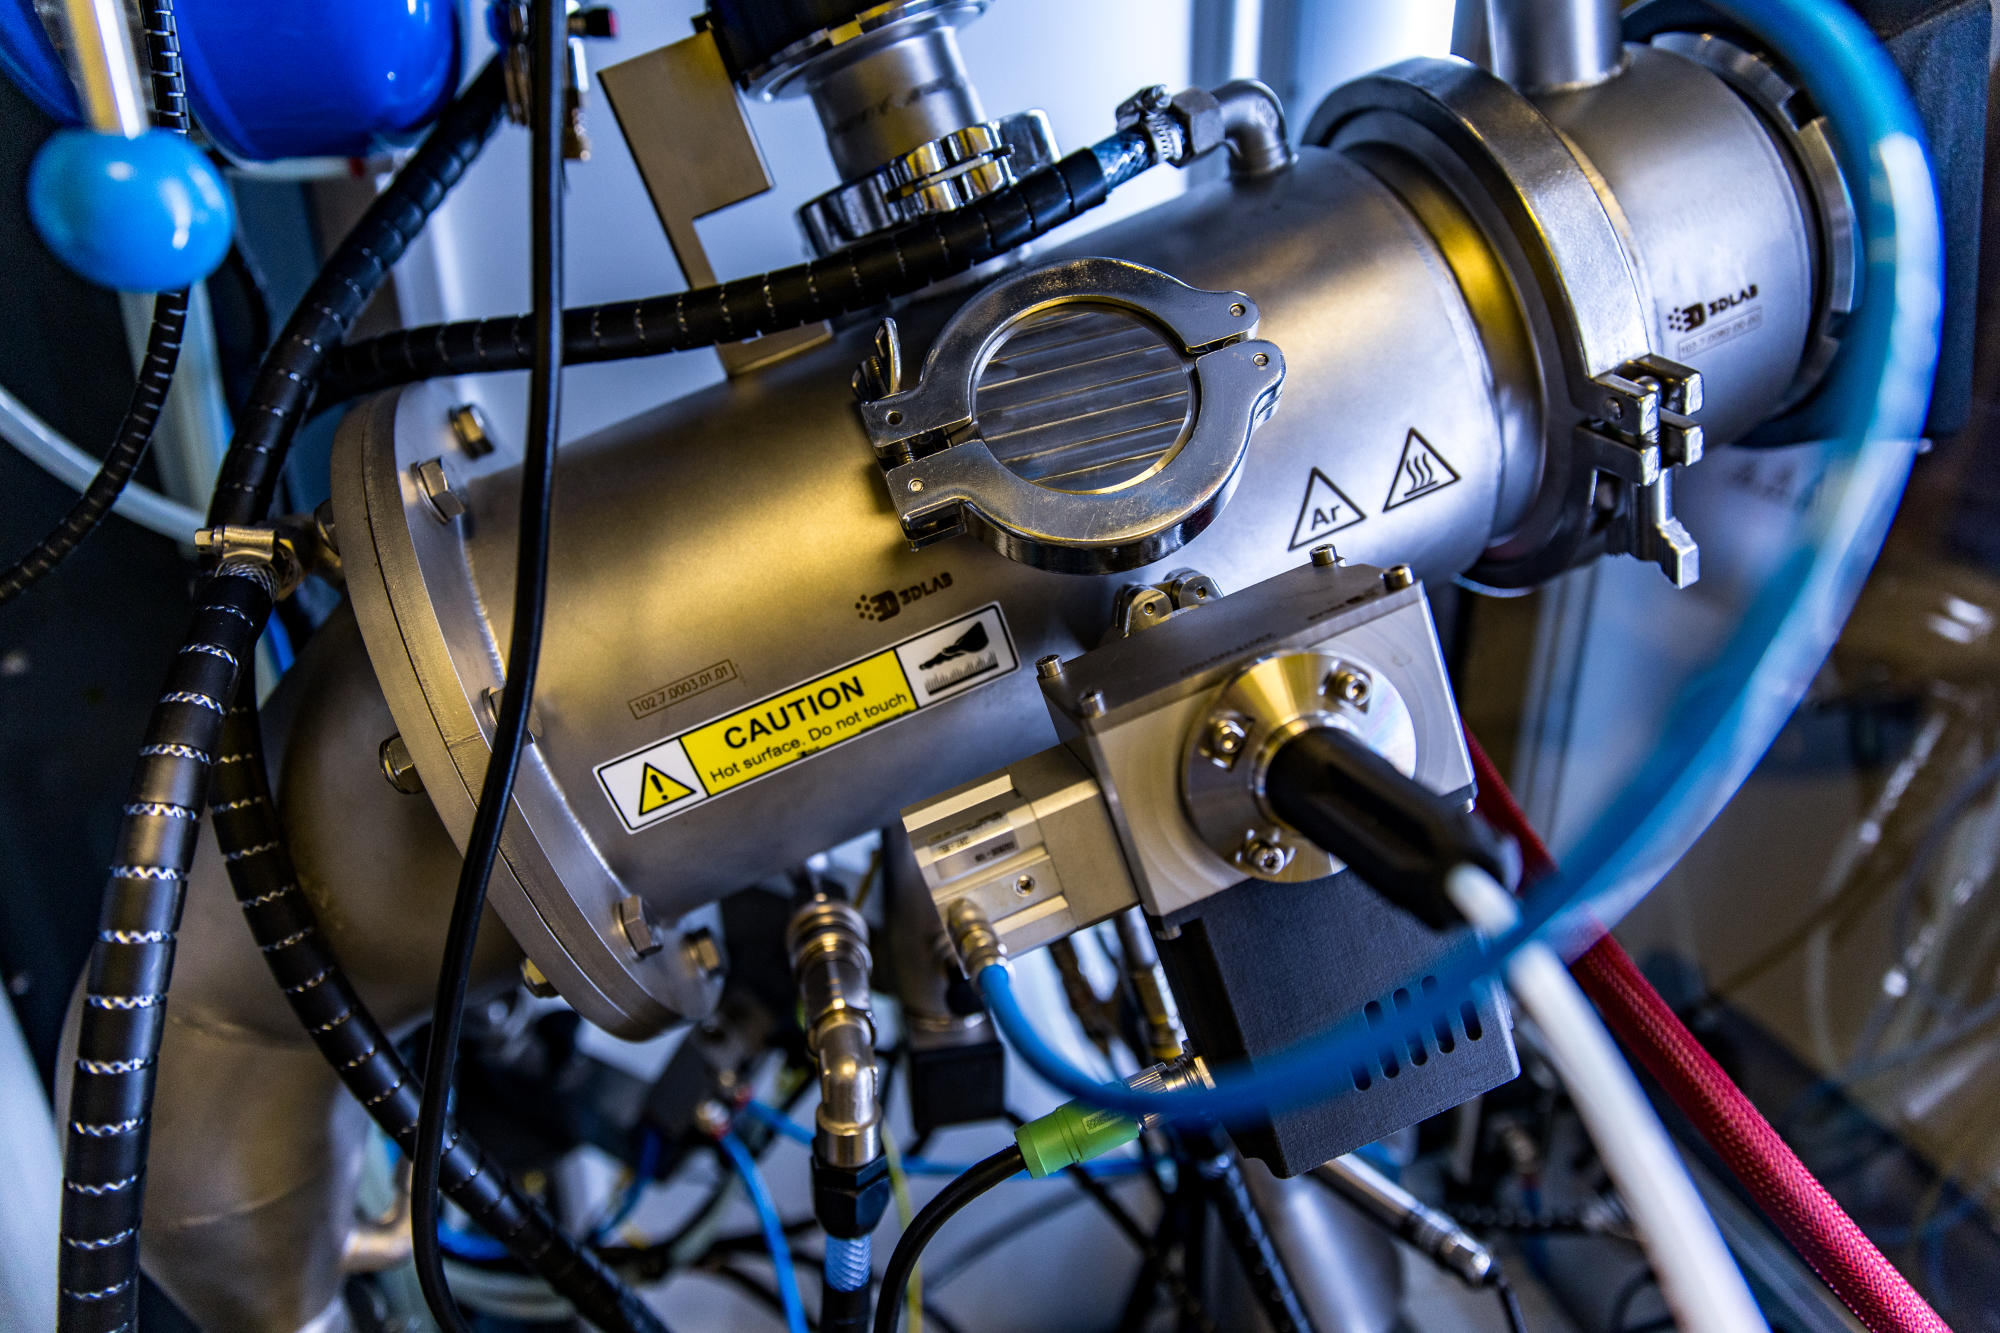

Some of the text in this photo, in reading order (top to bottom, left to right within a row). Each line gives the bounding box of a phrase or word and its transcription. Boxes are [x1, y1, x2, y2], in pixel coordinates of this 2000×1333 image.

[1708, 284, 1759, 316] 3DLAB
[1311, 505, 1341, 531] Ar
[898, 572, 954, 606] 3DLAB
[723, 675, 865, 749] CAUTION
[709, 762, 741, 783] Hot
[807, 727, 833, 742] Do
[836, 712, 862, 731] not
[863, 692, 908, 719] touch
